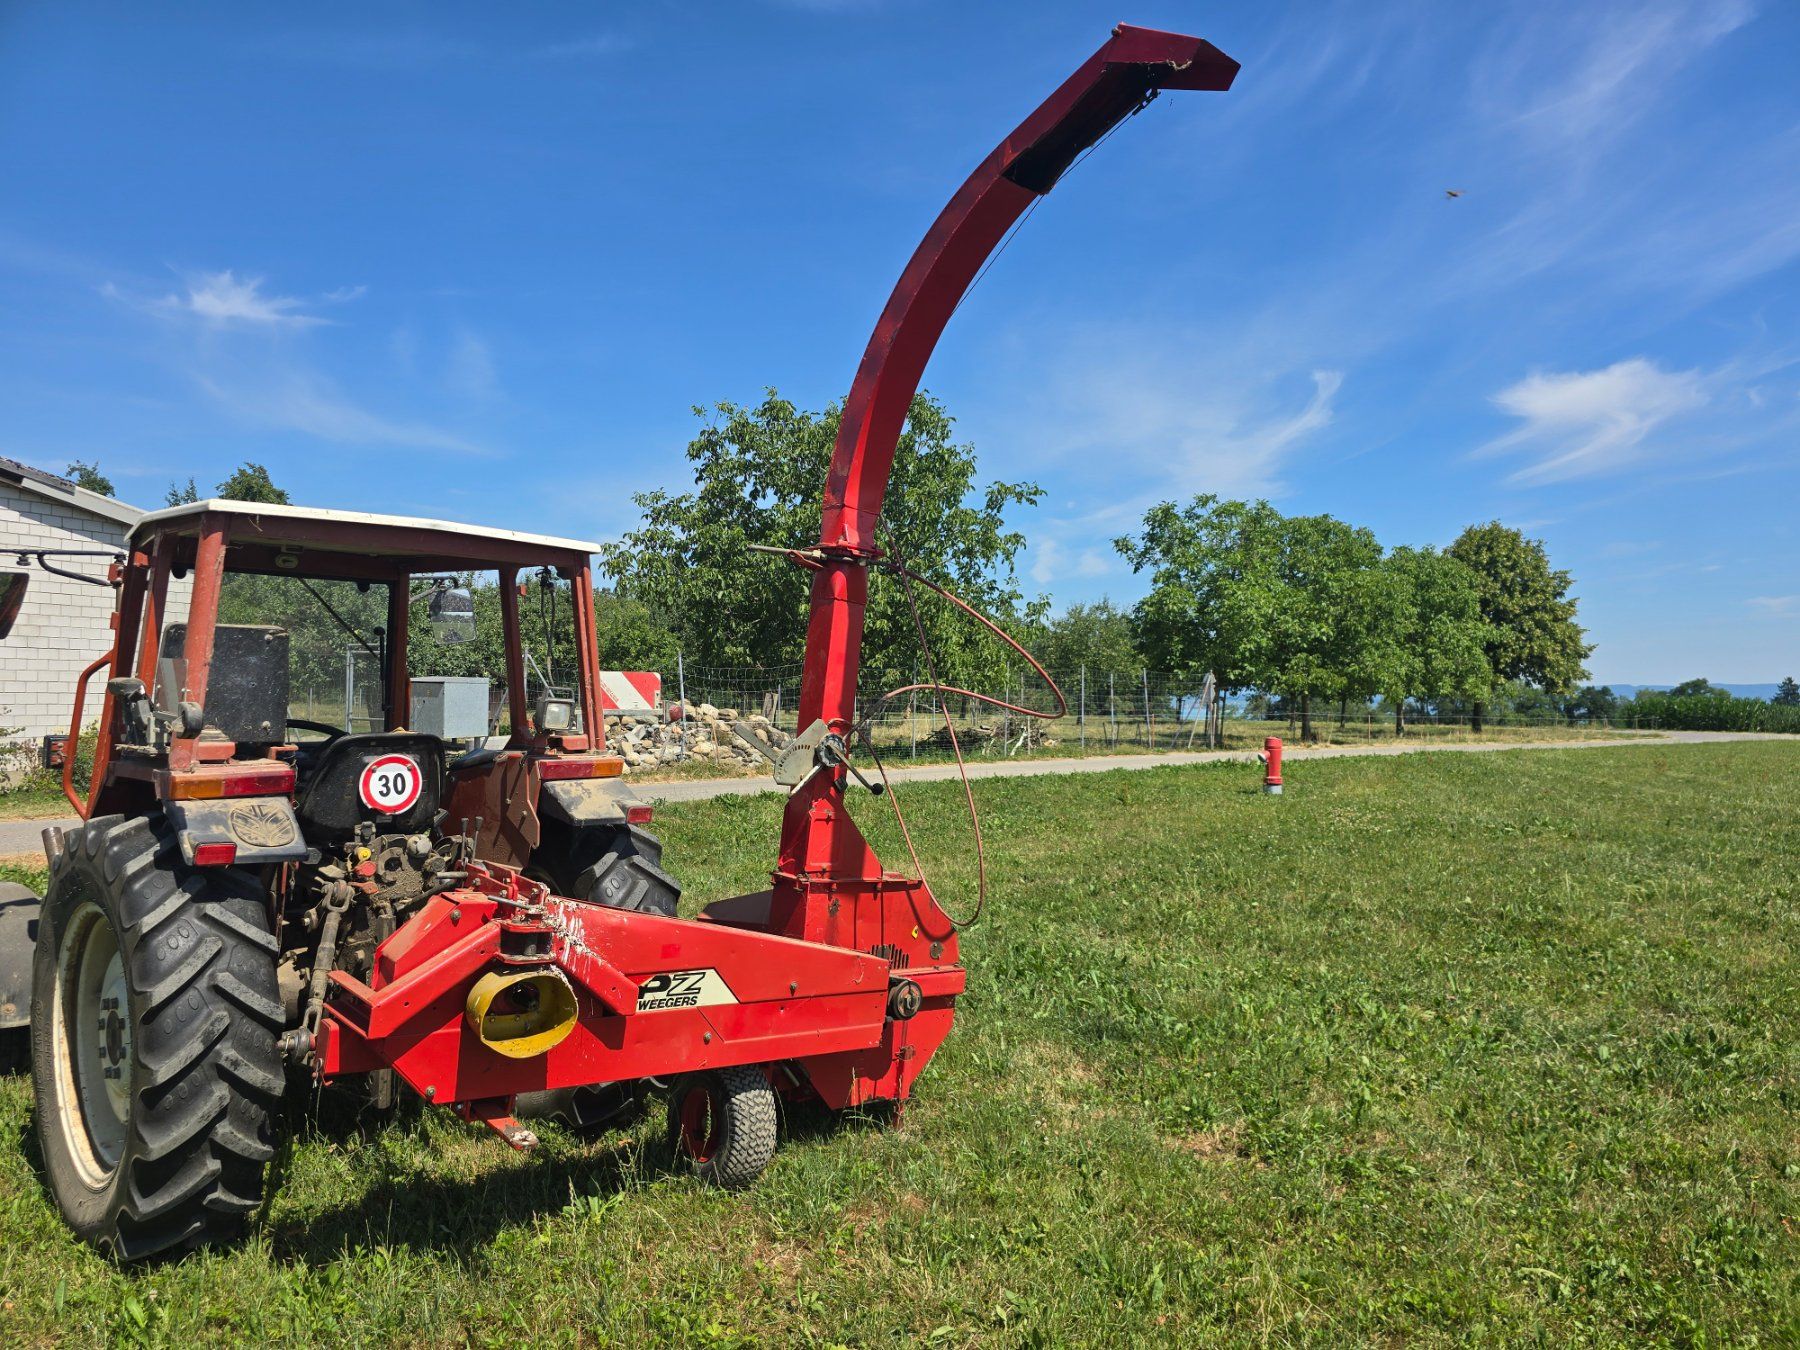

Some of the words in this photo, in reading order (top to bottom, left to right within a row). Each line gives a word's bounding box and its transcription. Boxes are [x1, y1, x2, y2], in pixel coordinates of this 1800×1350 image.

[378, 773, 406, 797] 30
[638, 972, 706, 999] PZ
[637, 996, 698, 1010] WEEGERS
